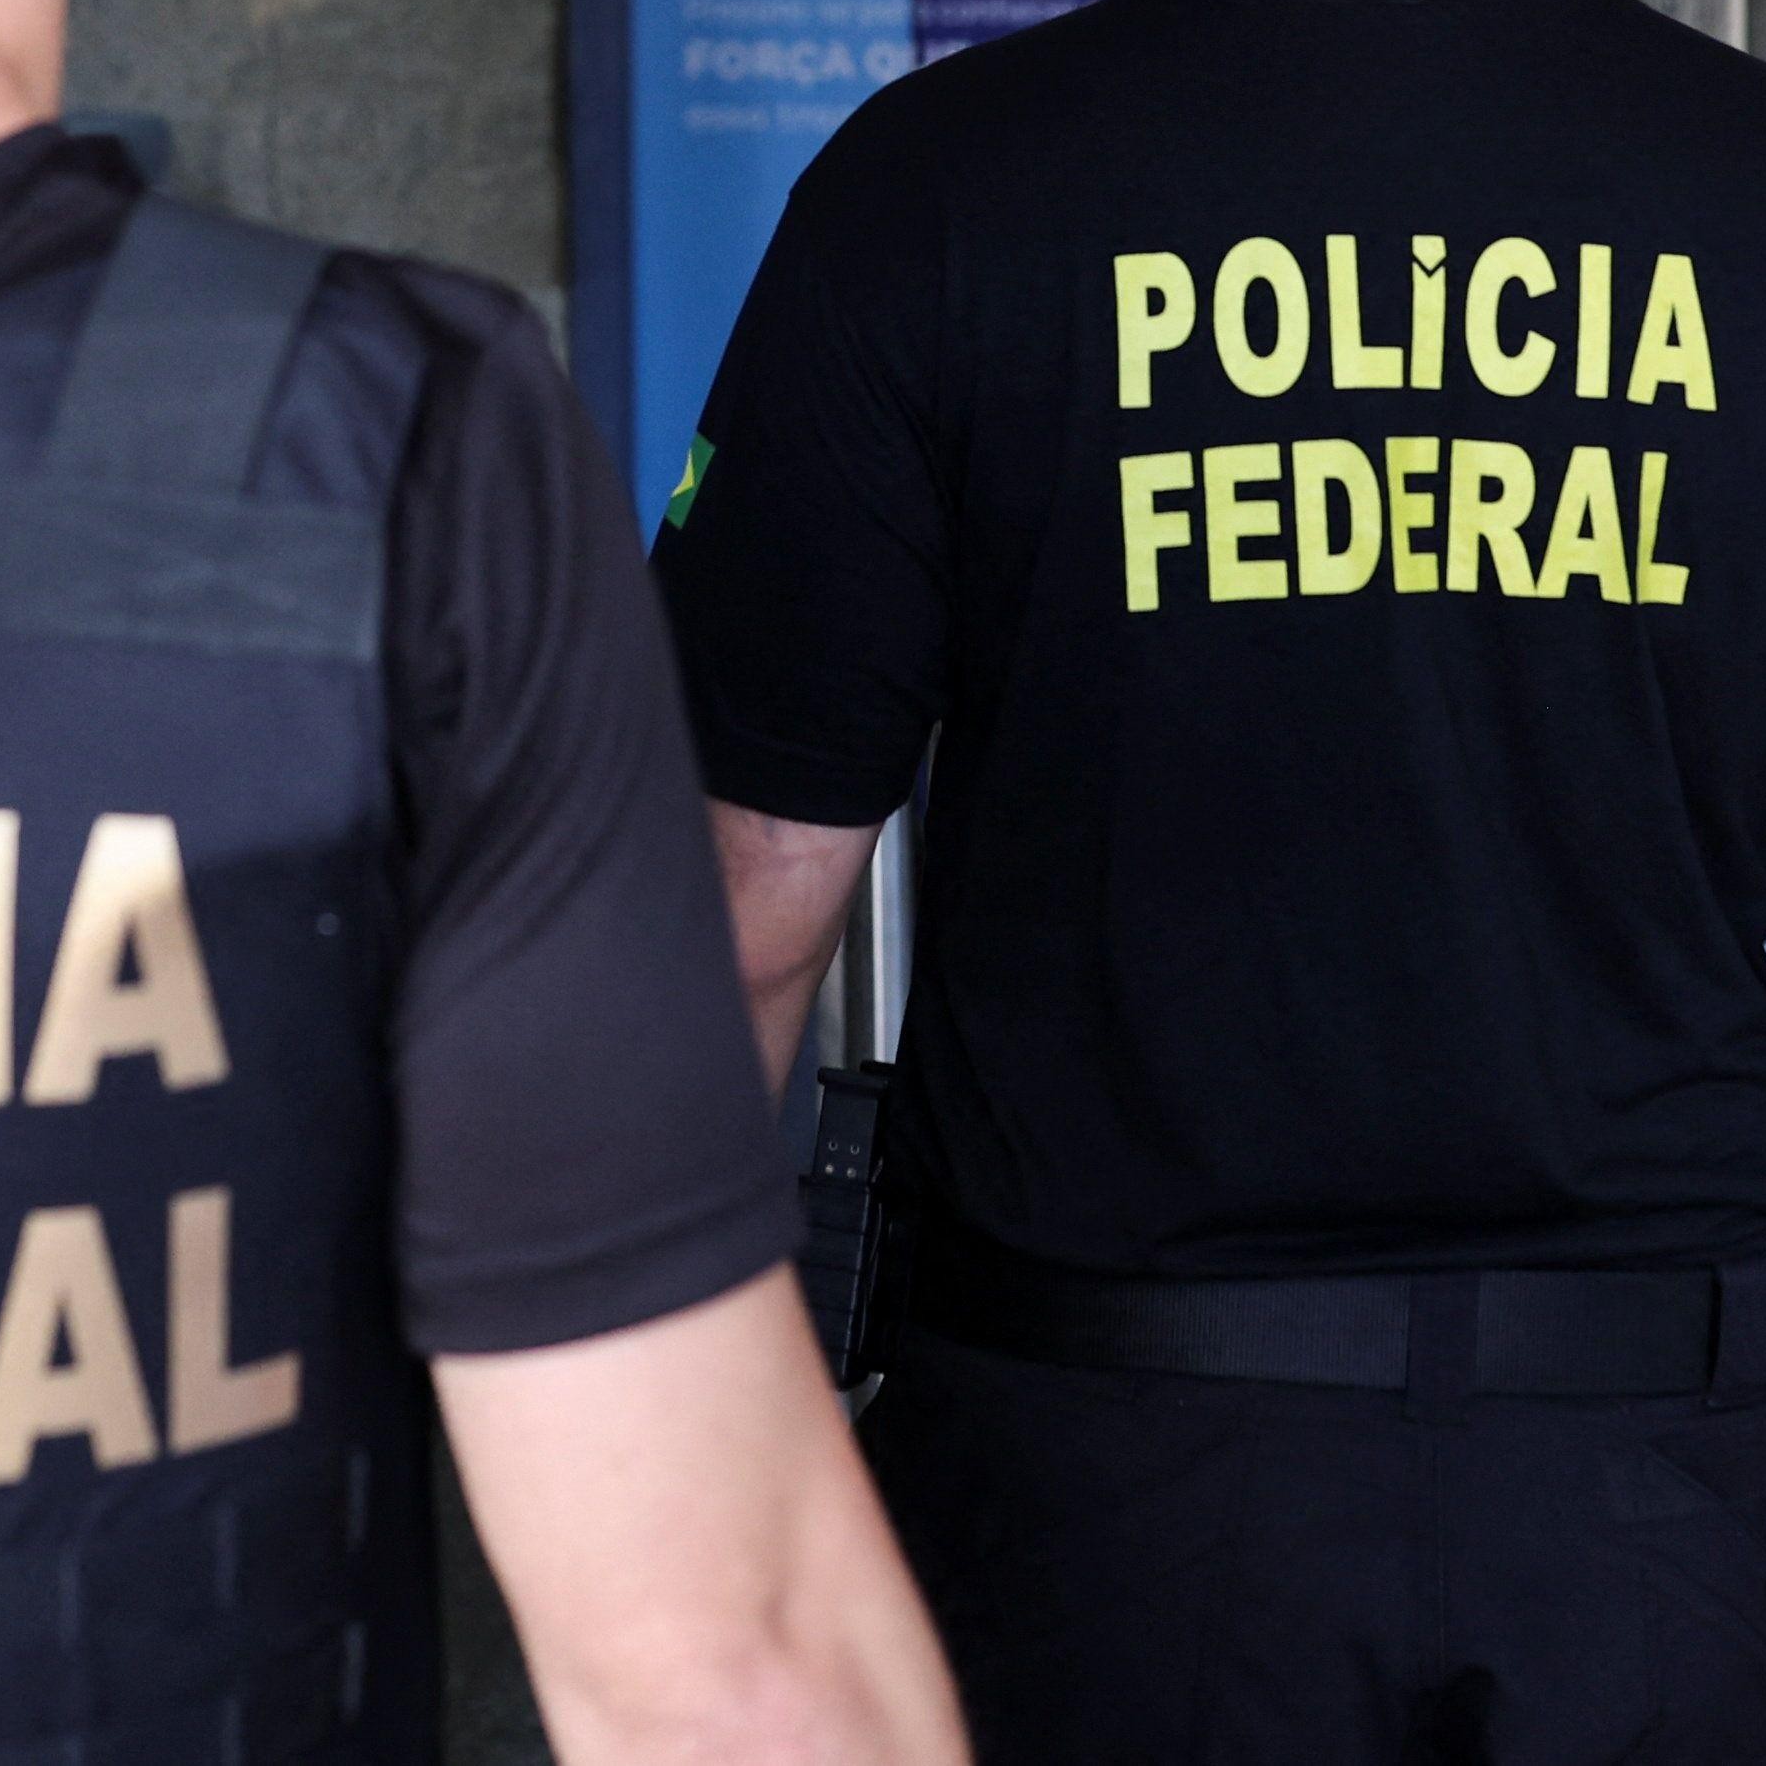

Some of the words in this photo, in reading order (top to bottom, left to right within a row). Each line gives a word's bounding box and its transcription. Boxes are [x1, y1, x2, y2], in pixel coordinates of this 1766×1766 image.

[683, 39, 857, 87] FORÇA
[1113, 233, 1718, 413] POLÍCIA
[1118, 435, 1691, 613] FEDERAL
